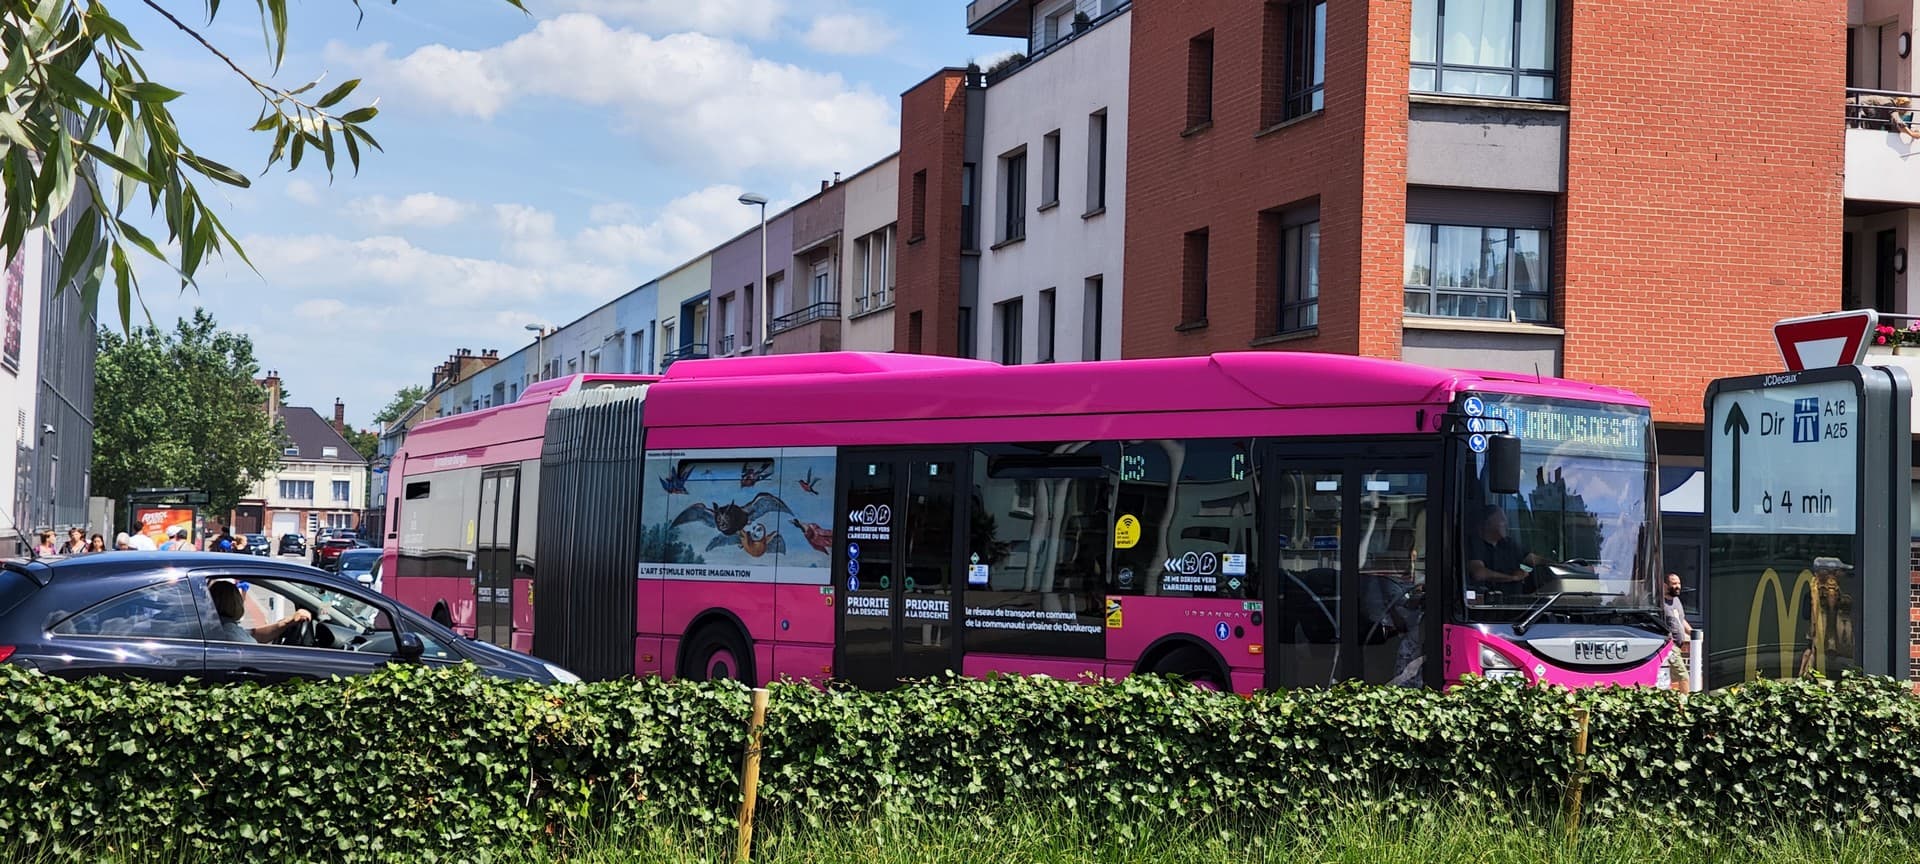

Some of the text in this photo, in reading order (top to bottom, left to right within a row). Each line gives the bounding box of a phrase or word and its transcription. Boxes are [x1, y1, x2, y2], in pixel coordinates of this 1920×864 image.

[1763, 374, 1797, 386] JCDecaux
[1824, 400, 1846, 417] A16
[1761, 411, 1785, 436] Dir
[1824, 423, 1848, 439] A25
[1762, 488, 1832, 514] à 4 min
[640, 567, 751, 578] L'ART STIMULE NOTRE IMAGINATION
[847, 597, 889, 608] PRIORITE
[905, 599, 949, 611] PRIORITE
[860, 608, 889, 616] DESCENTE
[919, 611, 949, 620] DESCENTE
[965, 607, 972, 615] le
[972, 607, 995, 616] réseau
[995, 608, 1004, 617] de
[1004, 608, 1035, 619] transport
[1045, 612, 1077, 620] commun
[965, 619, 1102, 634] de la communauté urbaine de Dunkerque
[1574, 640, 1628, 660] IVECO
